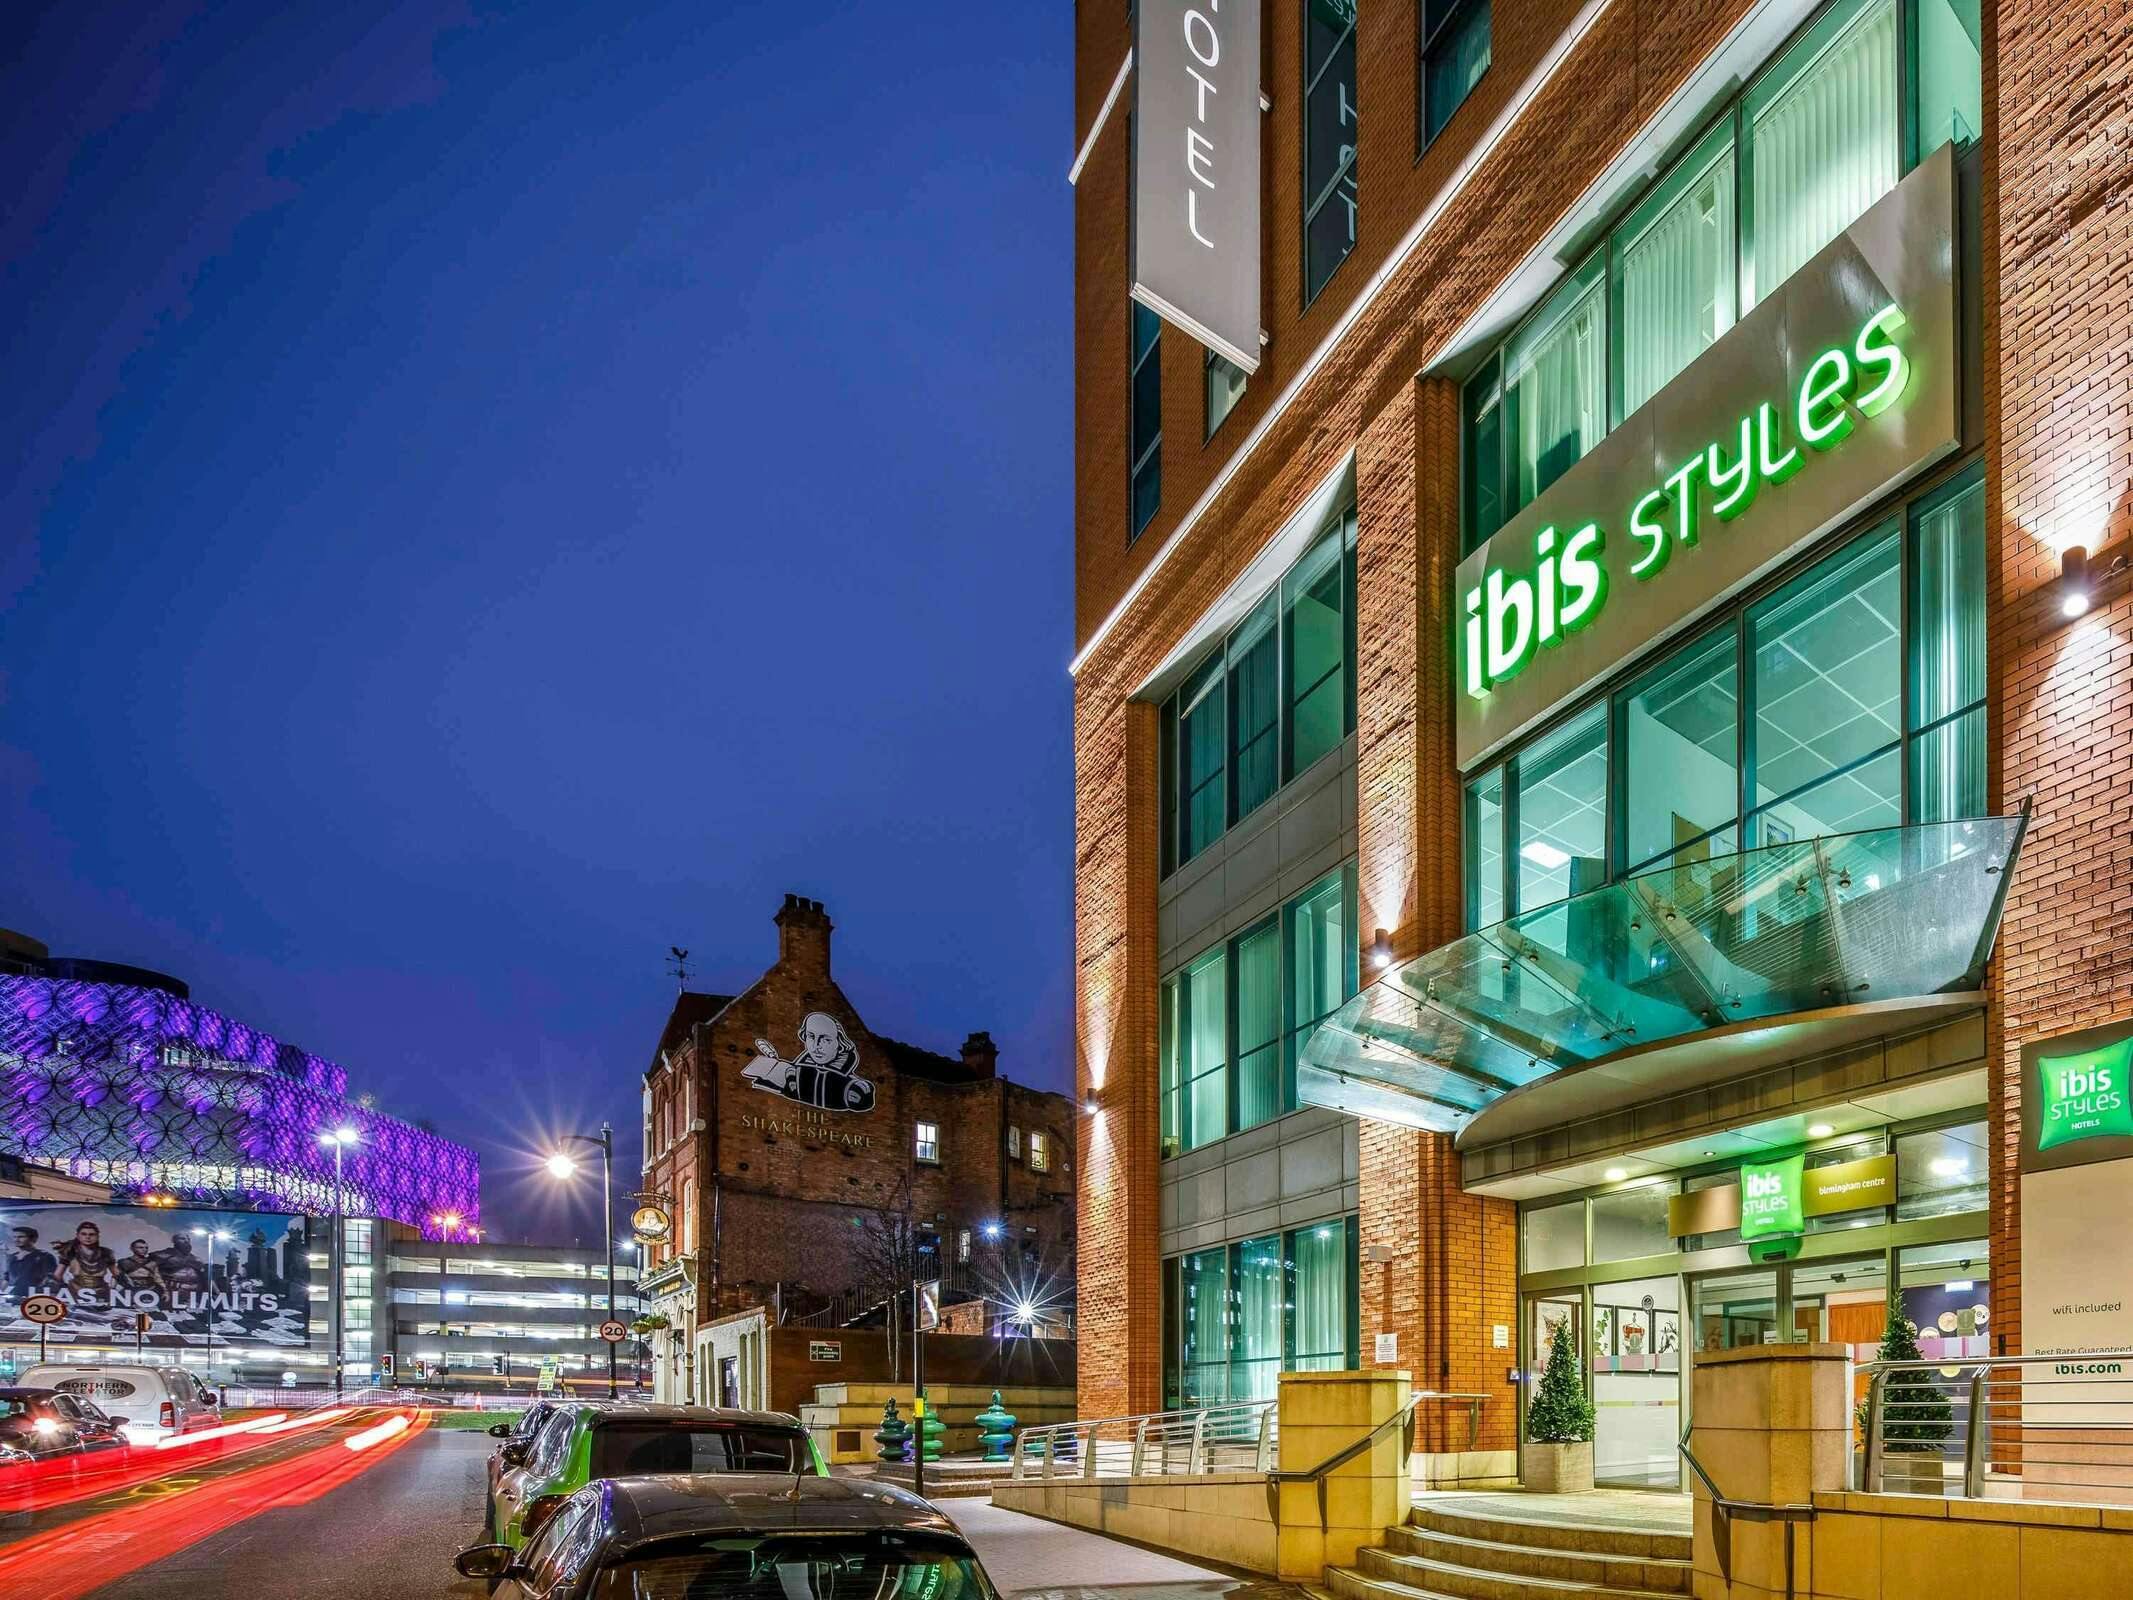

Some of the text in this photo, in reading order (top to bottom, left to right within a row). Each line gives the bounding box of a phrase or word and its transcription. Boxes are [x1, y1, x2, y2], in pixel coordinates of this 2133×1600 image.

[1183, 0, 1220, 249] OTEL
[1466, 524, 1606, 700] ibis
[2059, 1064, 2112, 1099] ibis
[792, 1109, 829, 1125] THE
[2071, 1118, 2101, 1130] HOTELS
[742, 1114, 872, 1148] SHAKESPEARE
[1747, 1171, 1782, 1198] ibis
[1818, 1177, 1886, 1196] birmingham centre
[110, 1288, 159, 1308] NO
[172, 1291, 279, 1312] LIMITS
[2052, 1301, 2122, 1315] wifi included
[28, 1303, 59, 1316] 20
[605, 1326, 624, 1337] 20
[2055, 1363, 2122, 1375] ibis.com
[63, 1381, 129, 1390] NORTHERN
